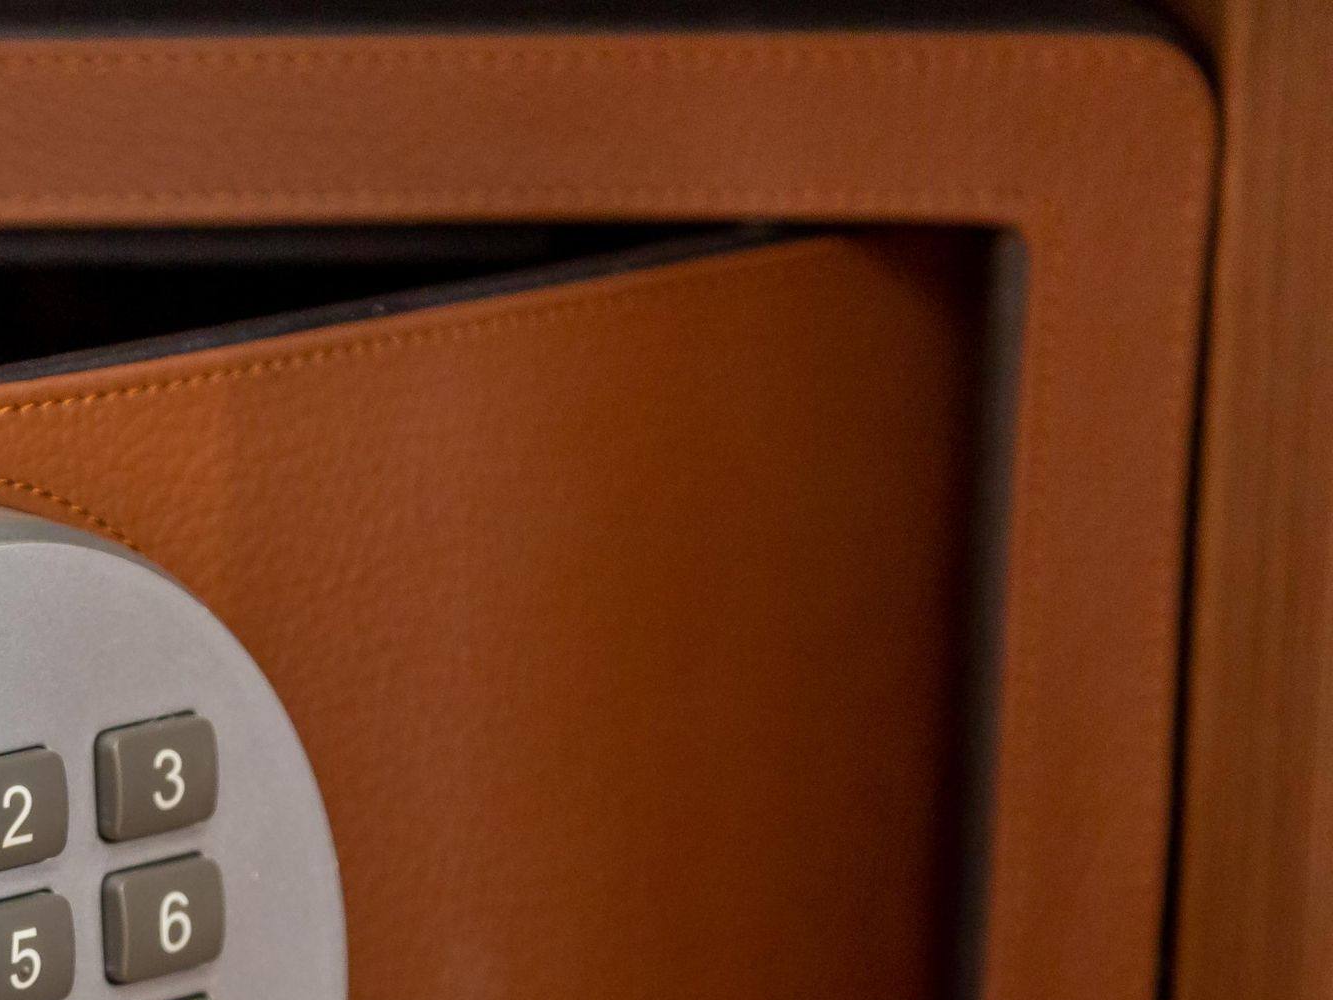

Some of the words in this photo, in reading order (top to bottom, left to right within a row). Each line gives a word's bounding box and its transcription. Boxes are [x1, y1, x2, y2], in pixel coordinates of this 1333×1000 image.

[152, 748, 186, 810] 3
[1, 785, 34, 849] 2
[159, 891, 192, 954] 6
[10, 928, 42, 990] 5
